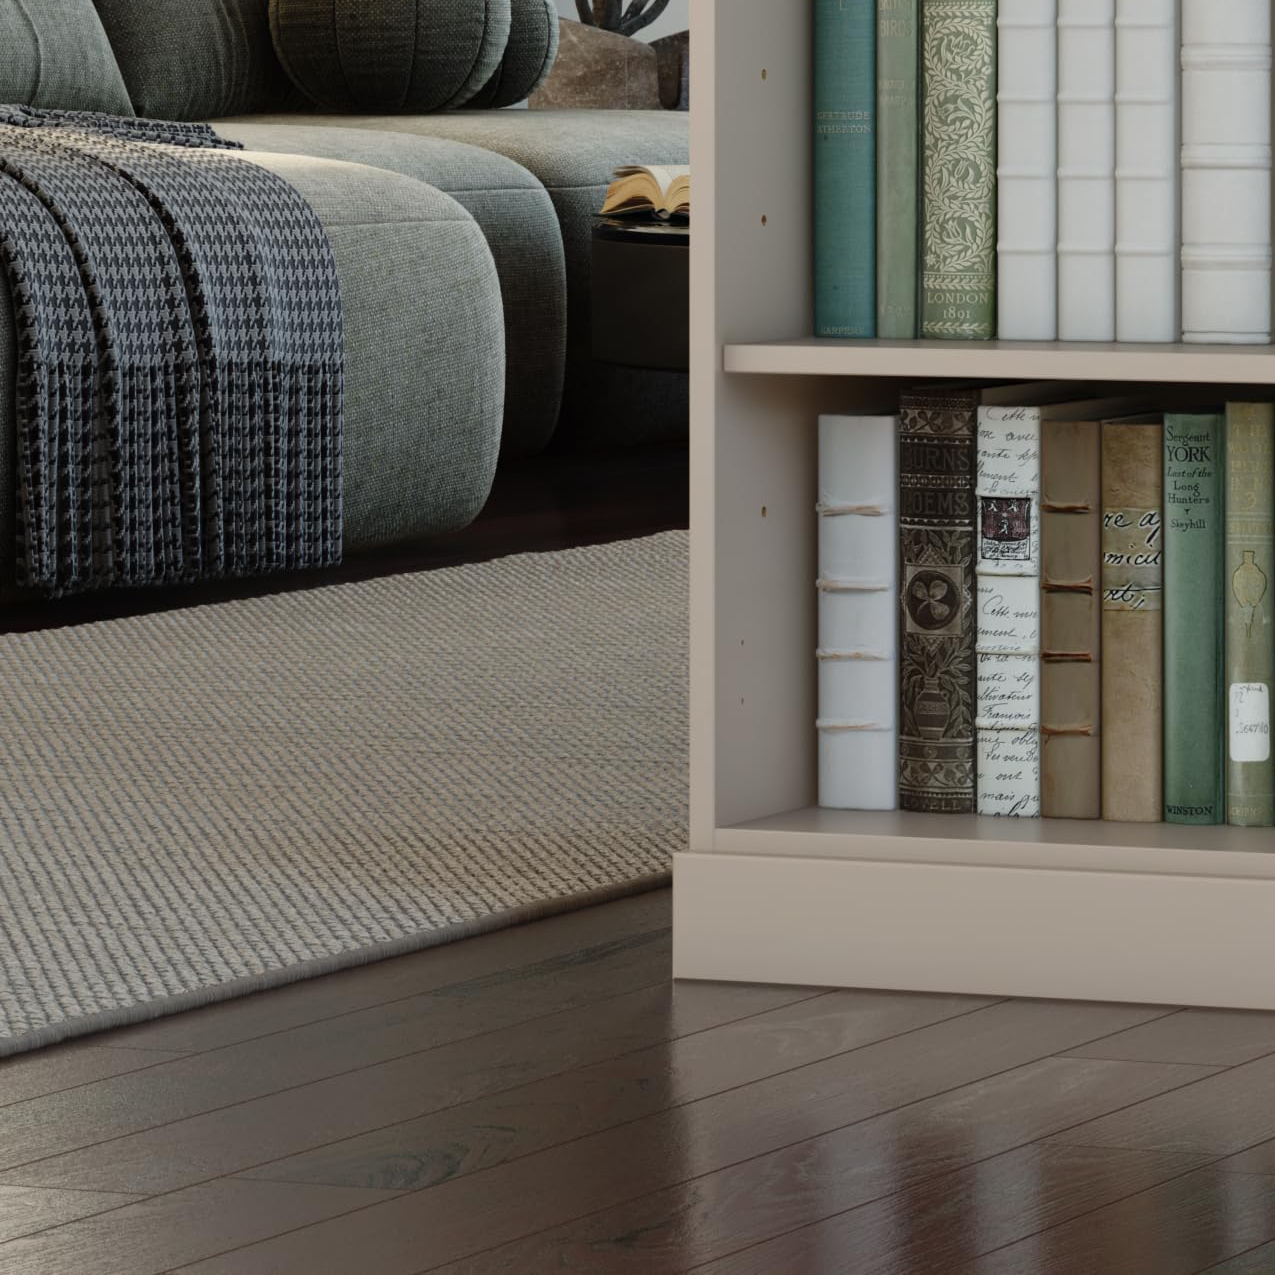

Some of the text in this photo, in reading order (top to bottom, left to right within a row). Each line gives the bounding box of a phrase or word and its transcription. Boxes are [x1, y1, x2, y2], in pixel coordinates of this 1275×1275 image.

[927, 292, 988, 304] LONDON
[943, 306, 971, 321] 1891
[1166, 425, 1211, 446] Sergeant
[1167, 446, 1211, 463] YORK
[1198, 466, 1212, 478] the
[1173, 481, 1200, 497] Long
[1168, 493, 1210, 504] Hunters
[1166, 805, 1213, 816] WINSTON
